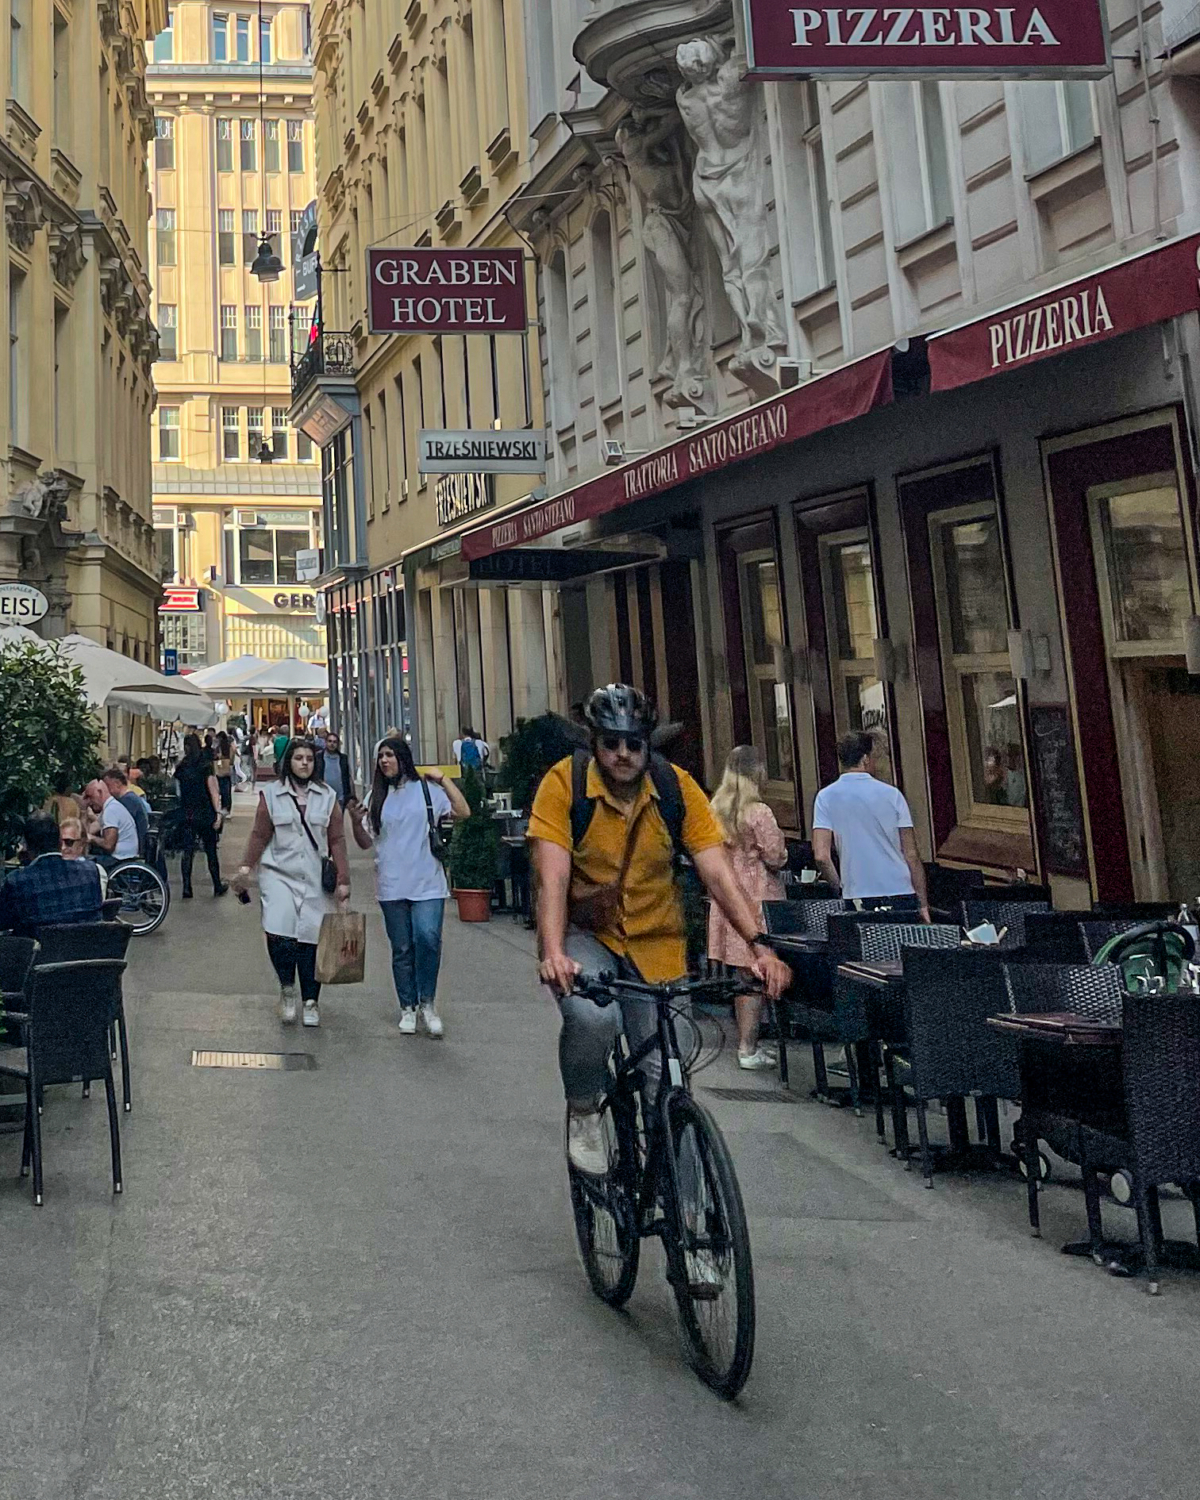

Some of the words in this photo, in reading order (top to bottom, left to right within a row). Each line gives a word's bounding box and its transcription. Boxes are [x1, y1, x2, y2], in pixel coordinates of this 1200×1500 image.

[788, 7, 1061, 46] PIZZERIA
[374, 259, 518, 285] GRABEN
[391, 297, 507, 324] HOTEL
[988, 285, 1114, 368] PIZZERIA
[425, 439, 537, 459] TRZEŚNIEWSKI
[623, 450, 678, 498] TRATTORIA
[688, 429, 726, 473] SANTO
[729, 403, 788, 457] STEFANO
